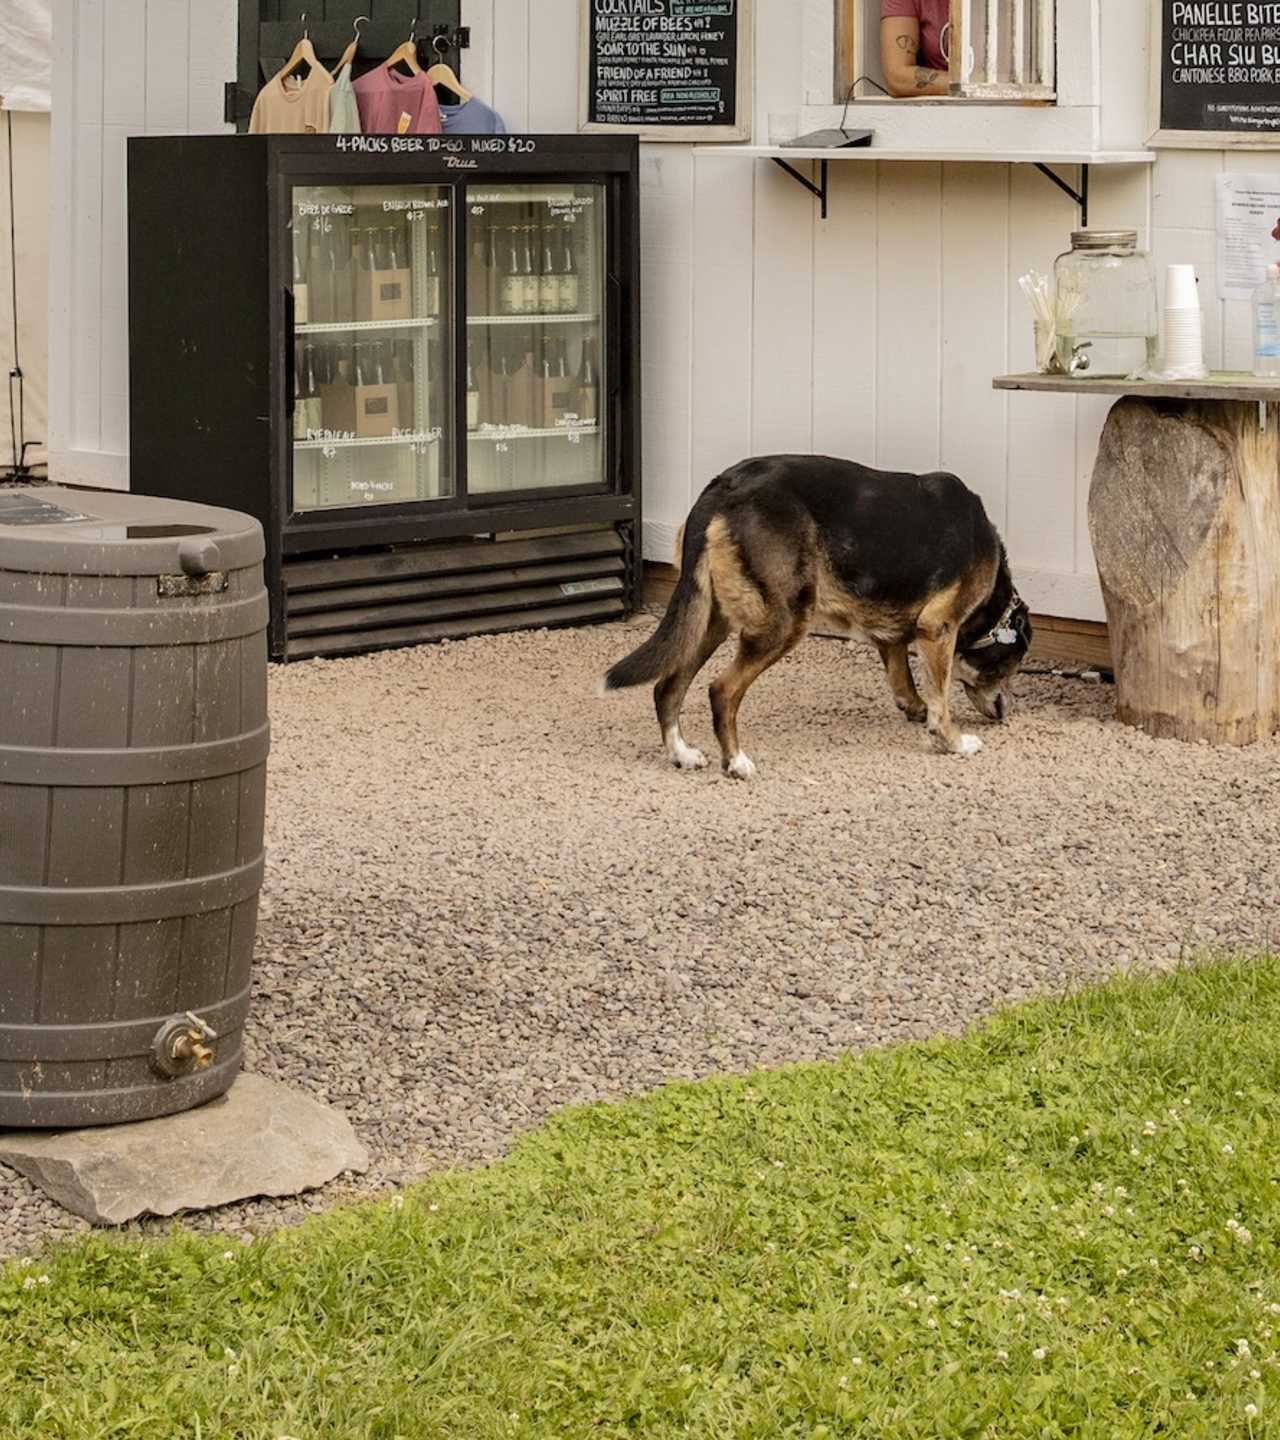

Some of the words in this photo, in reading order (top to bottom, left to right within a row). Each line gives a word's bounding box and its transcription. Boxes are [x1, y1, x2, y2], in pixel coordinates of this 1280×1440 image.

[1172, 2, 1243, 26] PANELLE
[595, 17, 641, 32] MUZZLE
[642, 17, 659, 31] OF
[660, 16, 693, 31] BEES
[1172, 27, 1217, 42] CHICKPEA
[596, 42, 624, 57] SOAR
[625, 42, 639, 56] TO
[639, 41, 661, 56] THE
[663, 41, 686, 58] SUN
[1171, 43, 1223, 66] CHAR
[1228, 44, 1256, 65] SIU
[596, 65, 634, 80] FRIEND
[655, 65, 692, 80] FRIEND
[1172, 67, 1227, 84] CANTONESE
[1228, 67, 1249, 84] BBQ
[596, 89, 629, 103] SPIRIT
[631, 89, 658, 103] FREE
[336, 135, 388, 153] 4-PACKS
[391, 137, 424, 152] BEER
[471, 137, 507, 153] MIXED
[507, 136, 536, 152] $20
